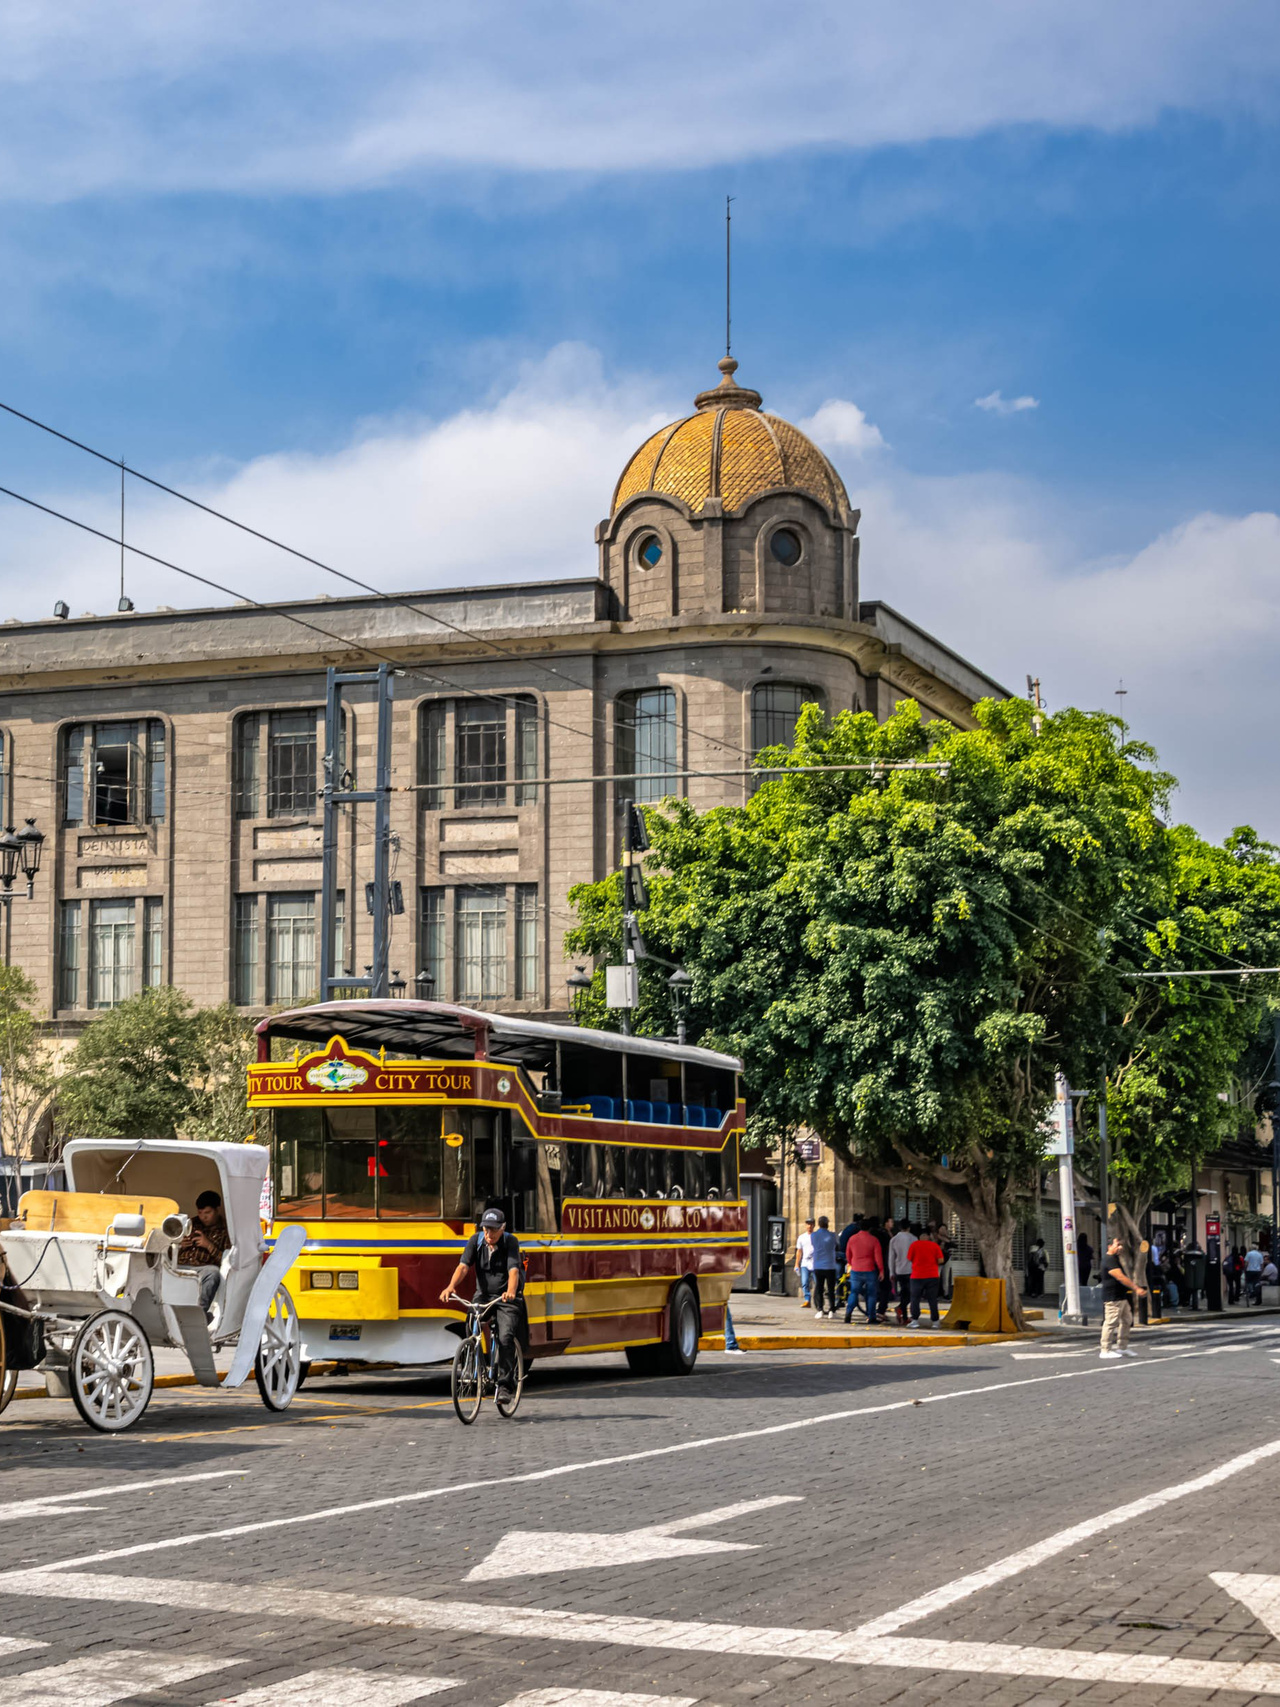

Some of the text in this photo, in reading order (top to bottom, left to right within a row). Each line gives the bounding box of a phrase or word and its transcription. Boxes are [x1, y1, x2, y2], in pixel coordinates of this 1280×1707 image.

[83, 838, 147, 851] DENTISTA
[247, 1076, 305, 1092] ITY TOUR
[375, 1074, 420, 1090] CITY
[426, 1073, 472, 1090] TOUR
[568, 1207, 639, 1229] VISITANDO
